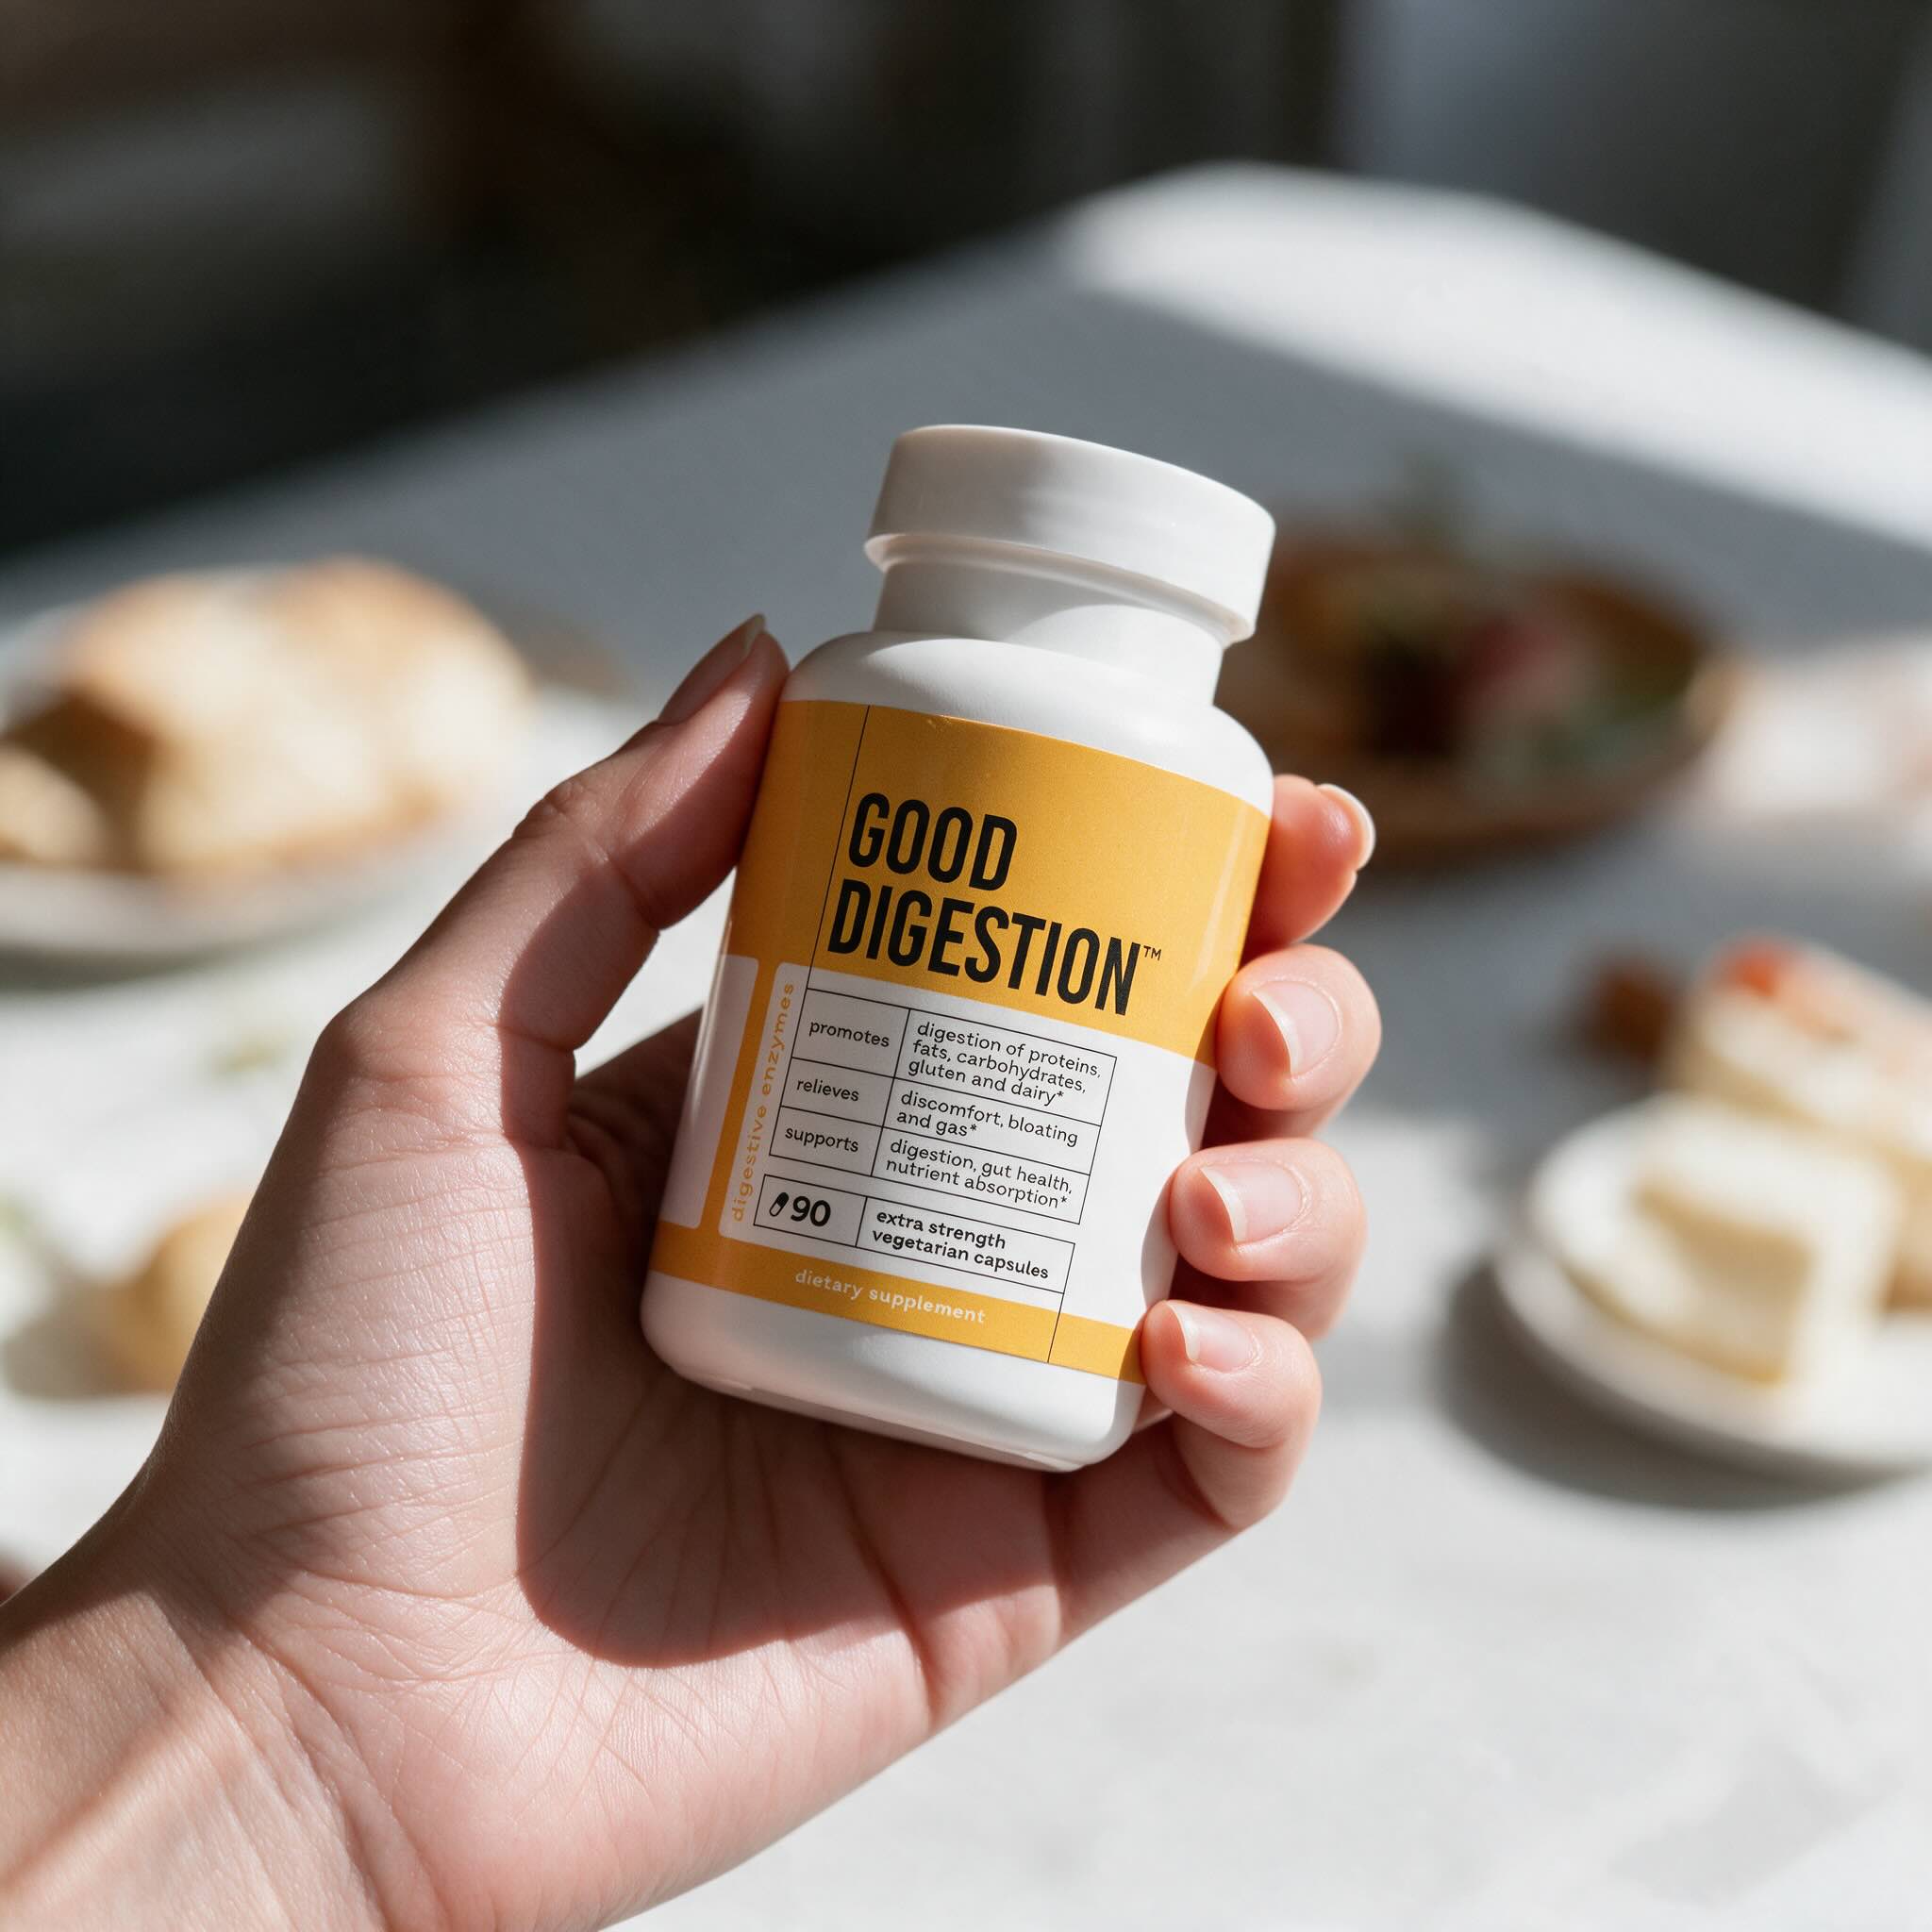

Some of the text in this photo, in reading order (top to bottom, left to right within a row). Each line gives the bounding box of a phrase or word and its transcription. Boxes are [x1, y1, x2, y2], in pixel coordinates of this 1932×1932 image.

[849, 792, 1017, 891] GOOD
[808, 1021, 890, 1048] promotes
[917, 1022, 1101, 1078] digestion of proteins,
[908, 1060, 966, 1084] gluten
[971, 1073, 1006, 1091] and
[912, 1040, 1086, 1092] fats, carbohydrates,
[731, 984, 794, 1222] digestive enzymes
[796, 1078, 859, 1102] relieves
[785, 1127, 858, 1152] supports
[896, 1111, 931, 1129] and
[901, 1091, 1078, 1147] discomfort, bloating
[886, 1159, 960, 1186] nutrient
[891, 1139, 1073, 1194] digestion, gut health,
[791, 1196, 831, 1226] 90
[876, 1210, 1006, 1249] extra strength
[872, 1230, 1049, 1279] vegetarian capsules
[795, 1270, 986, 1323] dietary supplement
